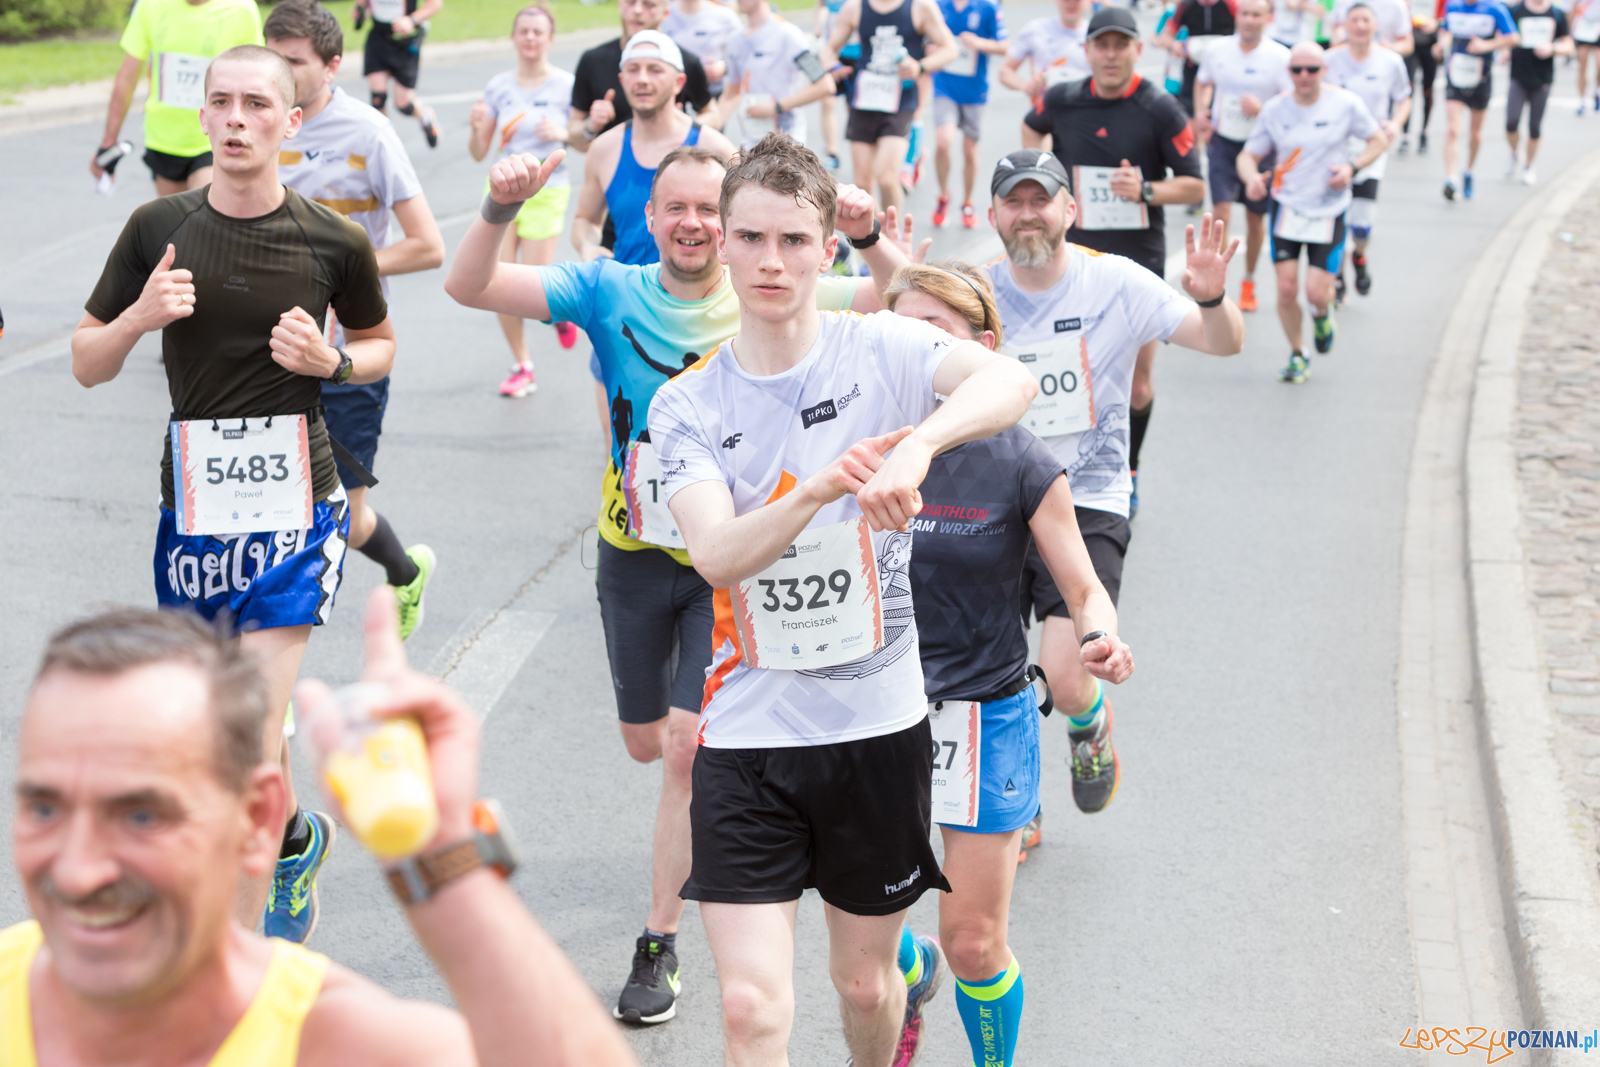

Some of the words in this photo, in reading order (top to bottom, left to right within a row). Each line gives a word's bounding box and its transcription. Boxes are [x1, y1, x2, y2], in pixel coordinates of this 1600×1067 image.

[722, 433, 743, 450] 4F
[206, 453, 289, 485] 5483
[234, 489, 263, 499] Paweł
[918, 503, 989, 521] RIATHLON
[939, 520, 1007, 536] WRZEŚNIA
[758, 568, 852, 612] 3329
[781, 614, 839, 630] Franciszek
[815, 643, 829, 652] 4F
